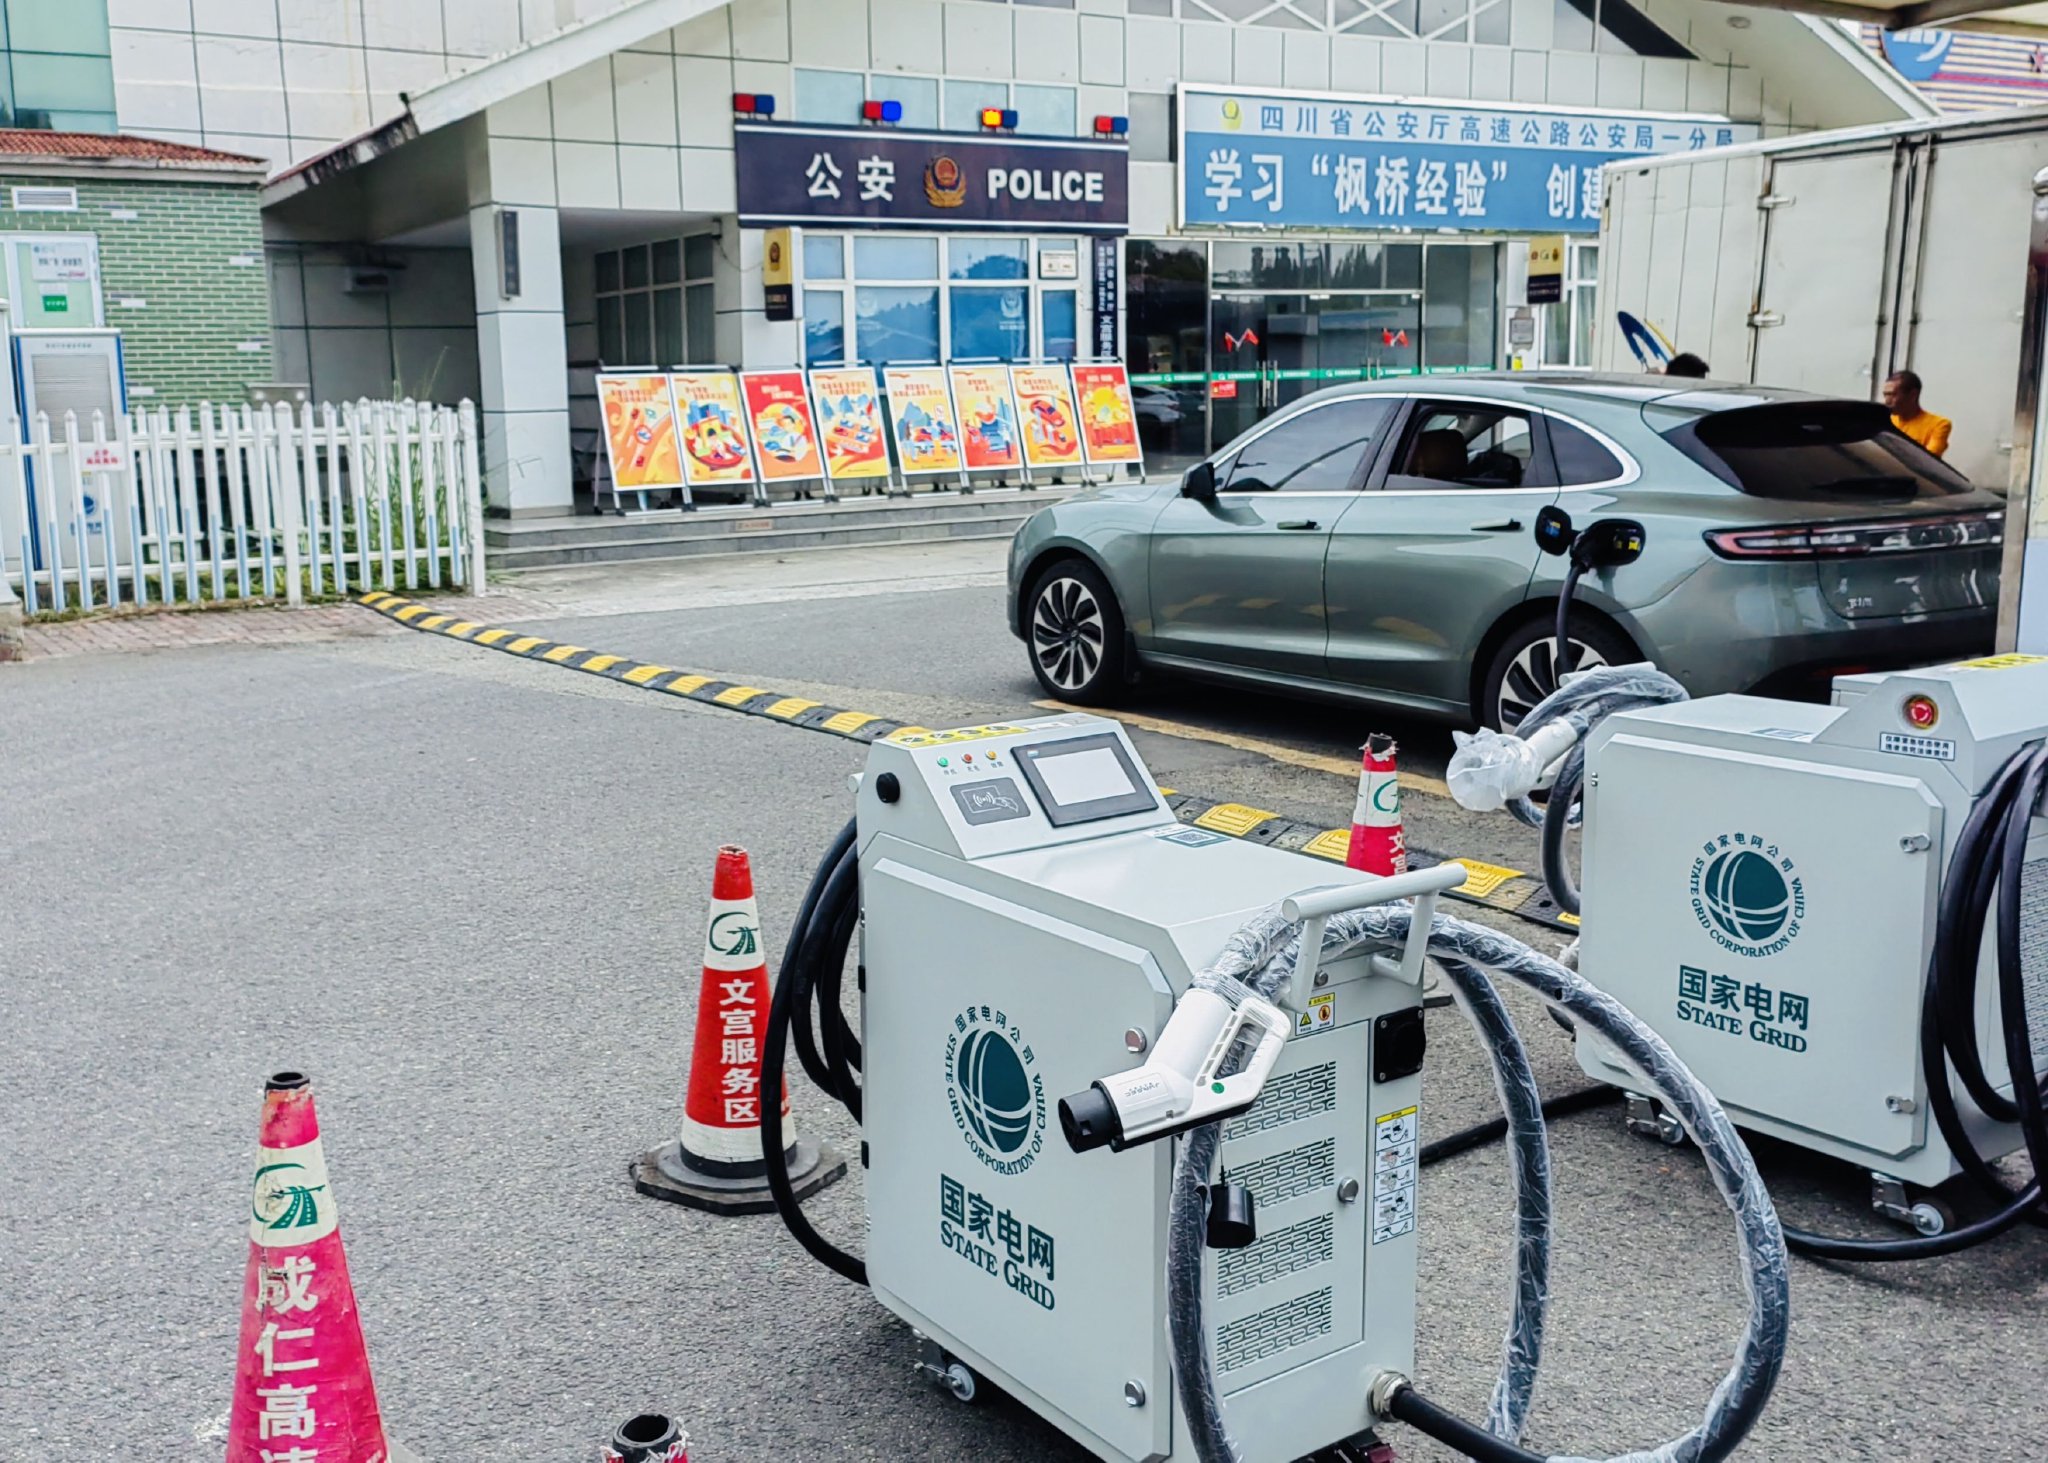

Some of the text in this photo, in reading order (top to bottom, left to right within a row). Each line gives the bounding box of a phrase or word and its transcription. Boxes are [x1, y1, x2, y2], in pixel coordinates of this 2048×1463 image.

[1261, 105, 1734, 150] 四川省公安厅高速公路公安局一分局
[805, 151, 896, 202] 公安
[987, 167, 1104, 202] POLICE
[1205, 148, 1284, 212] 学习
[1312, 152, 1507, 217] “枫桥经验”
[1703, 832, 1794, 873] 国家电网公司
[1690, 857, 1805, 958] STATE GRID CORPORATION OF CHINA
[1676, 999, 1808, 1054] STATE GRID
[1678, 964, 1810, 1031] 国家电网
[719, 978, 760, 1123] 文宫服务区
[954, 1004, 1035, 1065] 国家电网公司
[945, 1033, 1047, 1175] STATE GRID CORPORATION OF CHINA
[940, 1173, 1054, 1281] 国家电网
[940, 1220, 1055, 1311] STATE GRID
